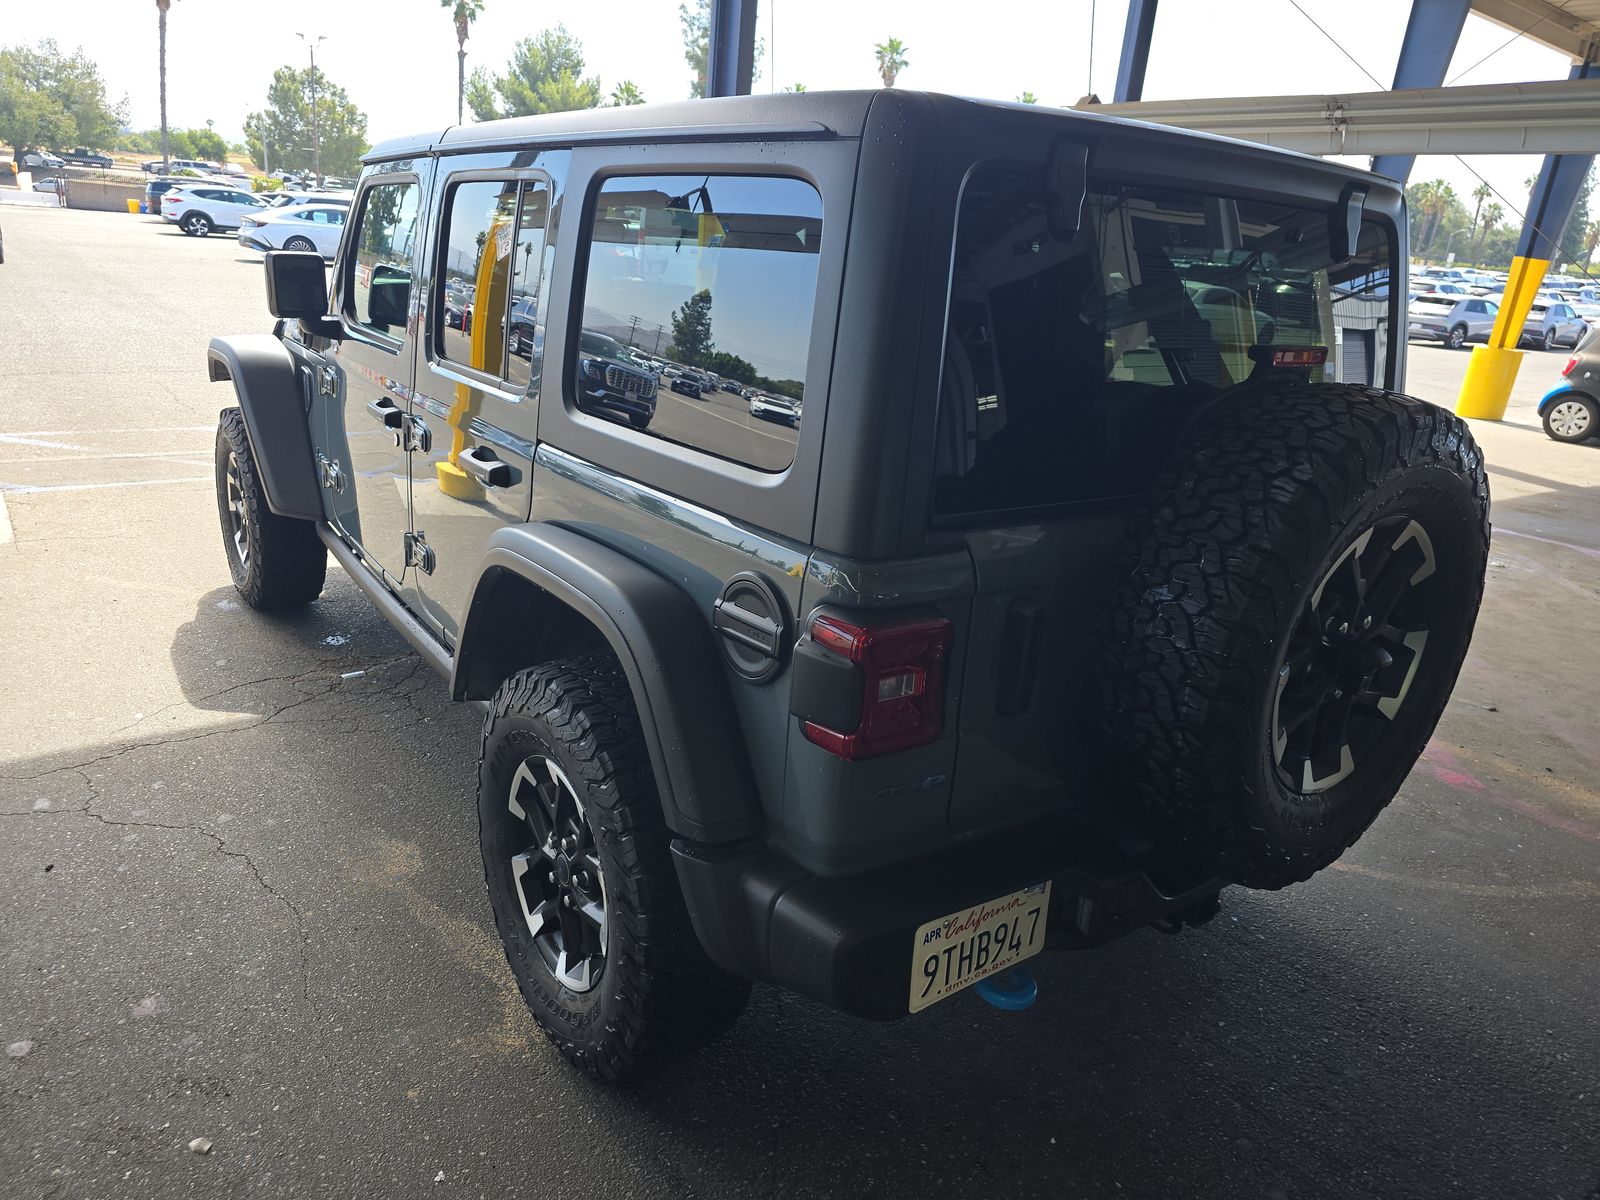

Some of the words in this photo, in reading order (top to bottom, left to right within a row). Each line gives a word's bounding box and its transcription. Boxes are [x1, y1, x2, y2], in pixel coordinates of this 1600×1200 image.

[923, 927, 942, 946] APR
[945, 895, 1028, 940] California
[921, 907, 1041, 998] 9THB947
[944, 955, 1014, 993] dmv.ca.gov
